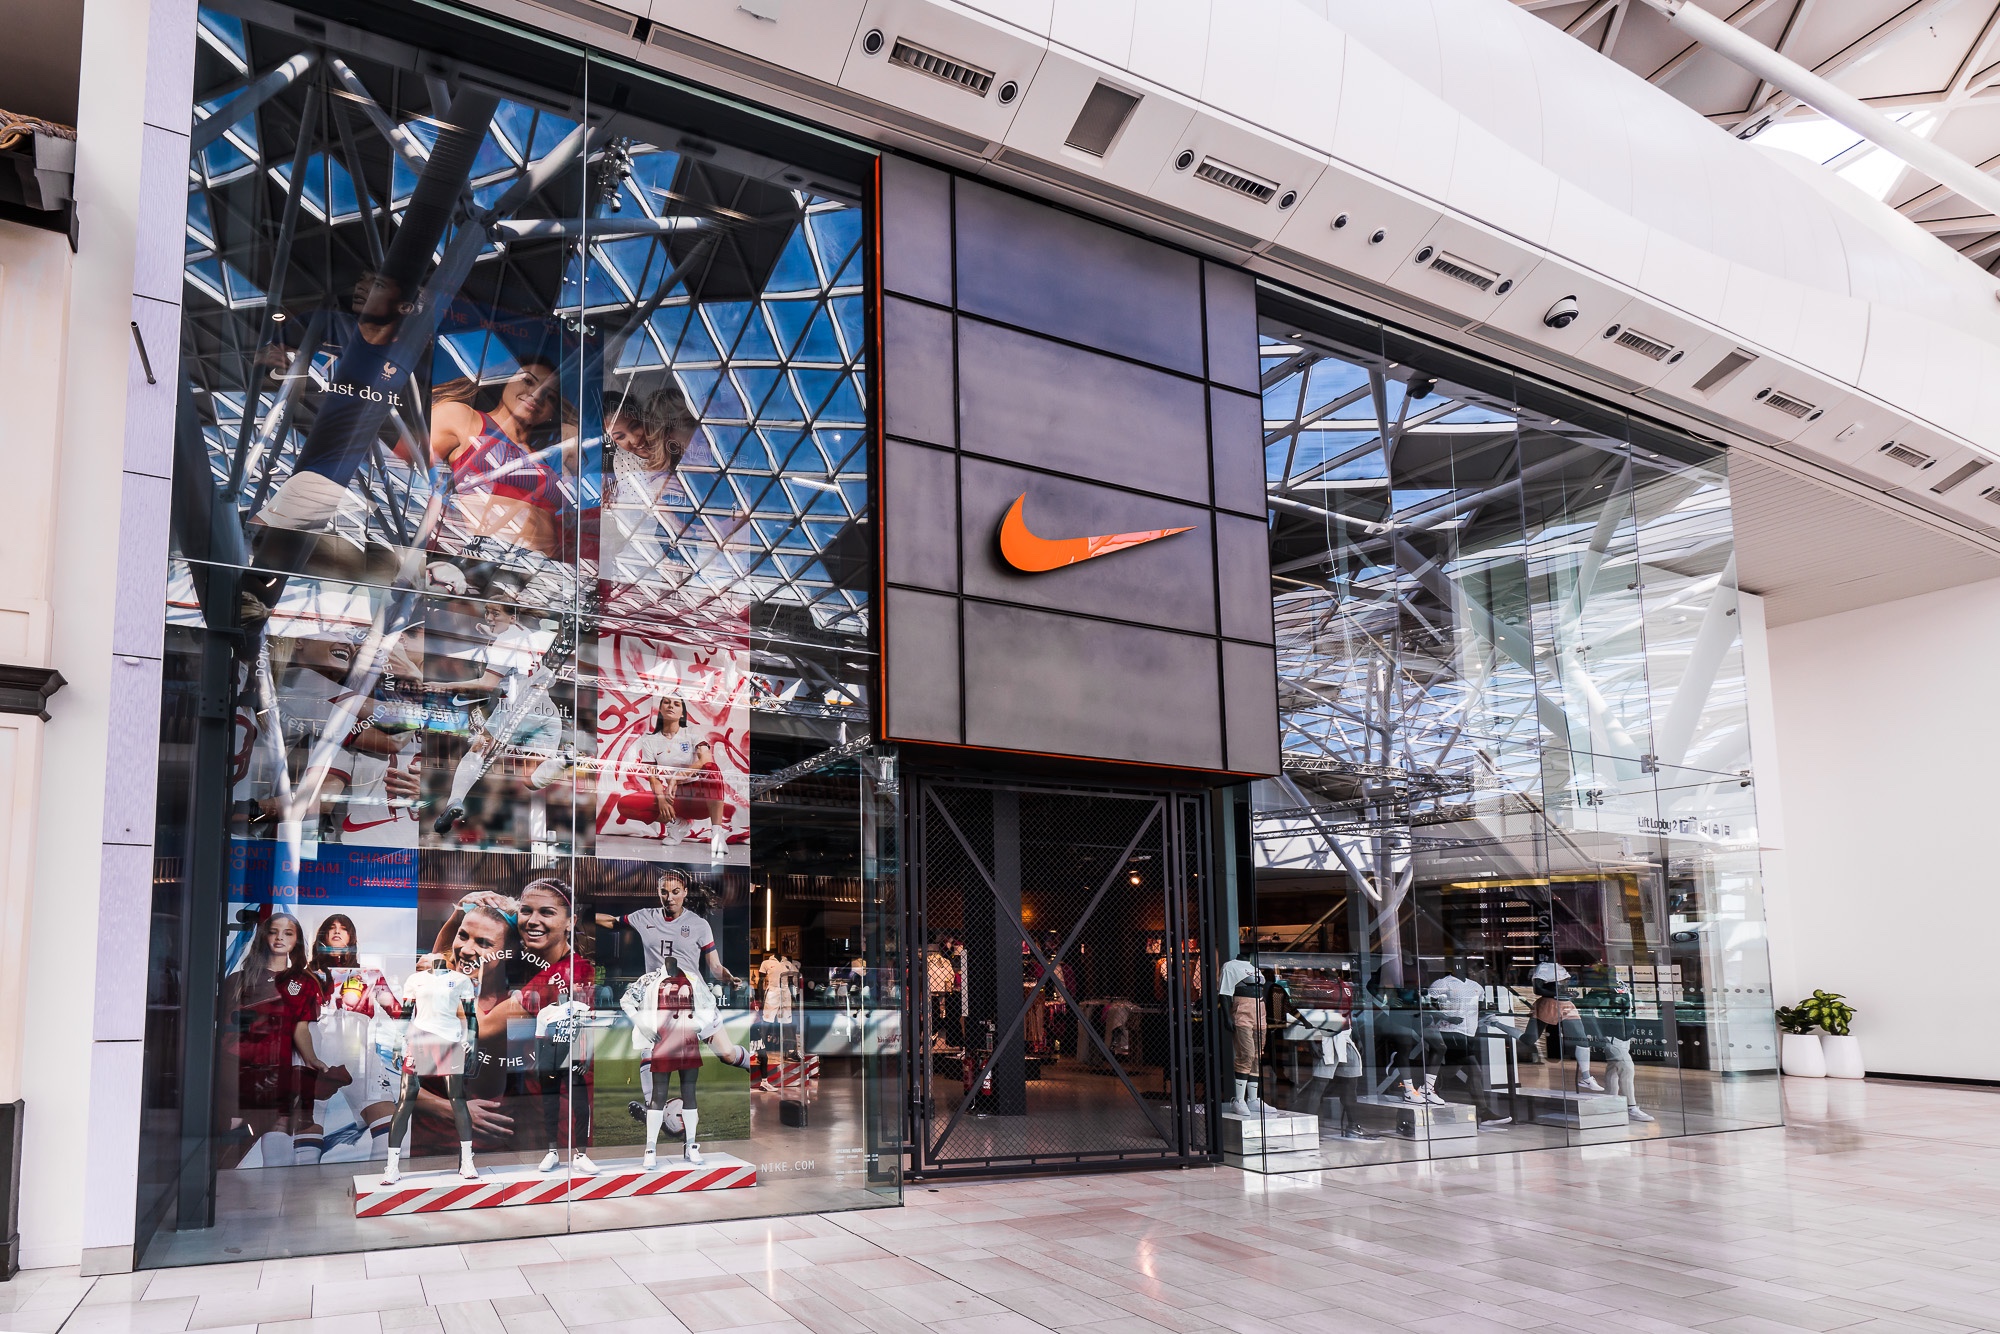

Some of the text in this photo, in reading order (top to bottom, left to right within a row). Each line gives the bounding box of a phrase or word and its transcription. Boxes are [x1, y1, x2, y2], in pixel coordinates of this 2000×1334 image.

[359, 385, 383, 402] do
[387, 391, 404, 407] it.
[255, 640, 274, 677] DON'T
[351, 704, 388, 735] WORLD
[559, 703, 573, 719] it.
[1638, 816, 1649, 829] Lift
[1650, 817, 1671, 833] Lobby
[230, 846, 413, 865] ON'T CHANGE
[347, 875, 413, 889] CHANGE
[660, 940, 673, 957] 13
[462, 949, 514, 976] CHANGE
[520, 950, 552, 972] YOUR
[717, 993, 731, 1007] it.
[555, 1020, 578, 1030] girs
[1631, 1048, 1679, 1058] JOHN LEWIS
[498, 1056, 524, 1068] THE
[761, 1160, 815, 1173] NIKE.COM
